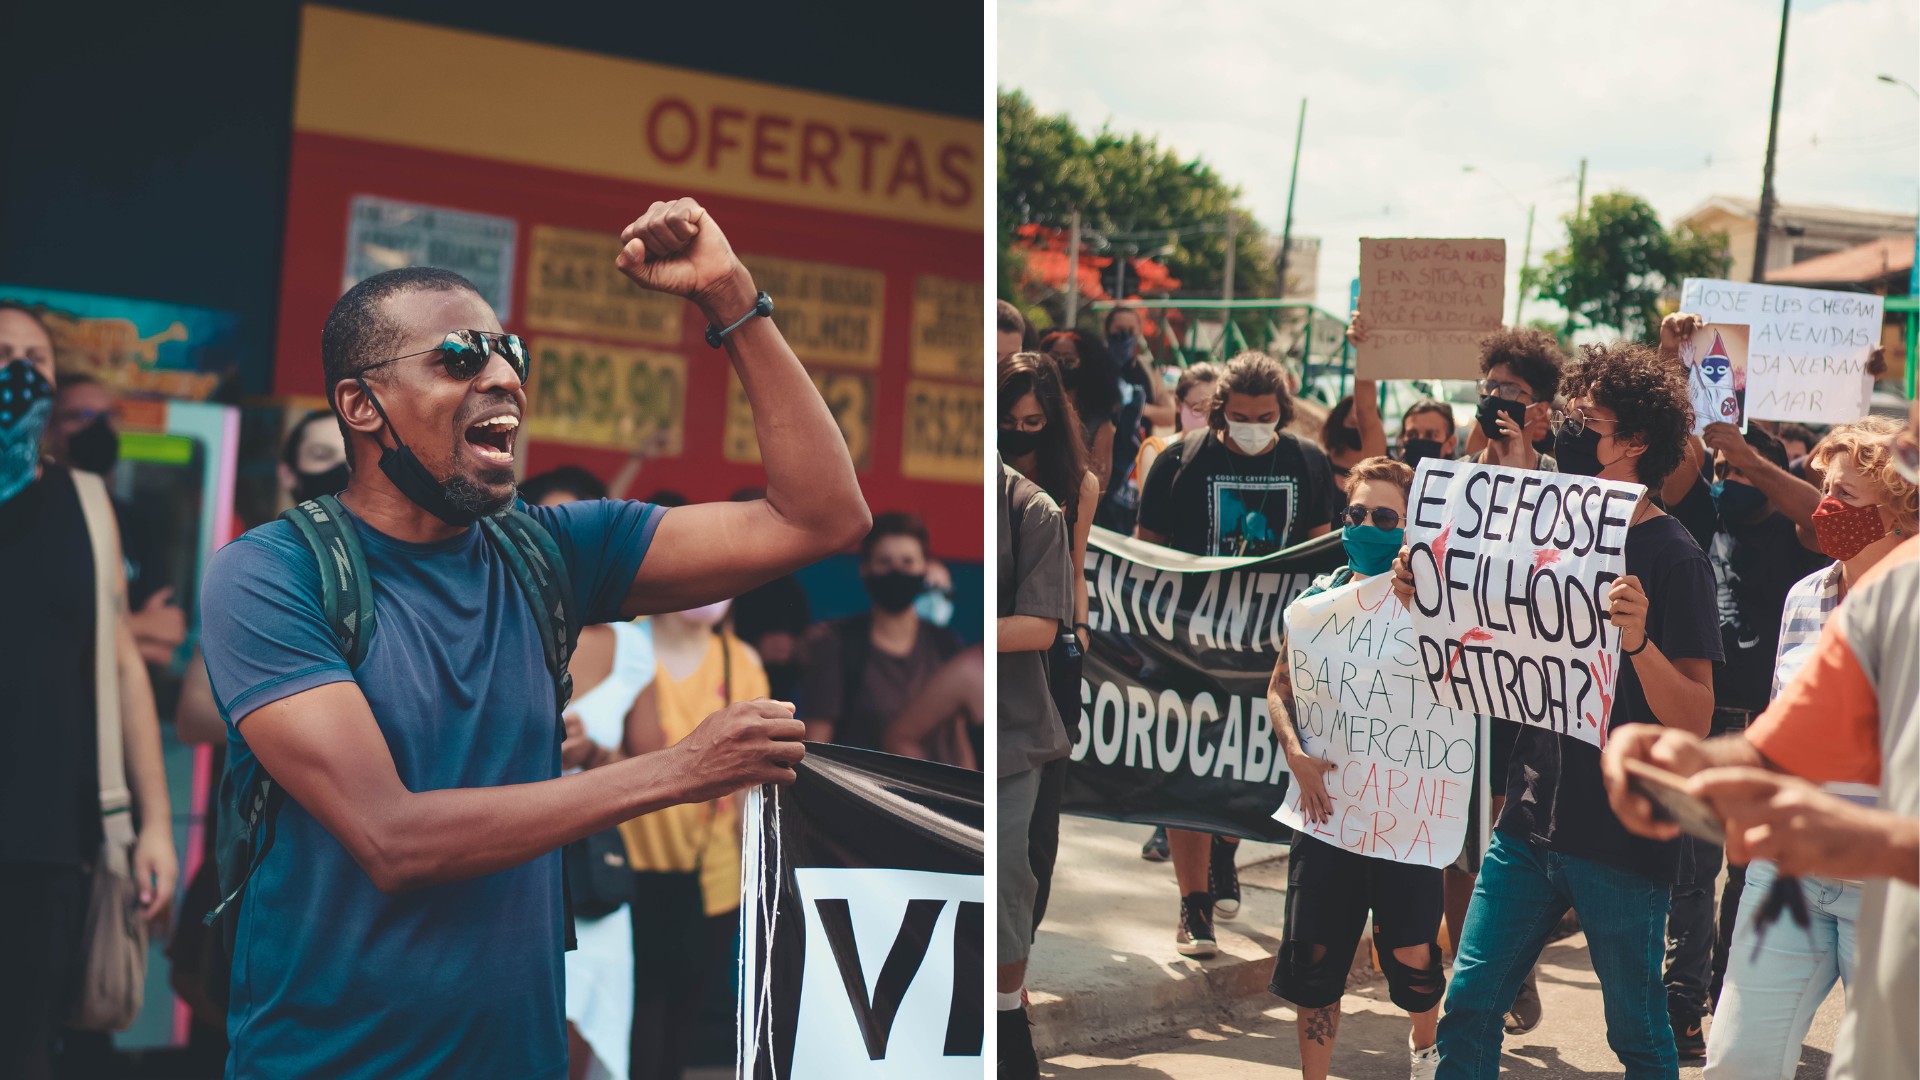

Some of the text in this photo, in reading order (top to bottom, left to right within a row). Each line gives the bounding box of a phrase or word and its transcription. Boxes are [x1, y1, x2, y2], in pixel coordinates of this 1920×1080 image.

[645, 96, 976, 208] OFERTAS
[1377, 269, 1410, 286] EM
[1686, 284, 1752, 312] HOJE
[1808, 297, 1875, 319] CHEGAM
[1757, 322, 1870, 347] AVENIDAS
[1787, 355, 1868, 377] VIERAM
[1757, 390, 1824, 412] MAR
[1414, 469, 1455, 529] E
[1419, 635, 1592, 735] PATROA?
[1295, 696, 1474, 775] DO MERCADO
[1342, 760, 1461, 820] CARNE
